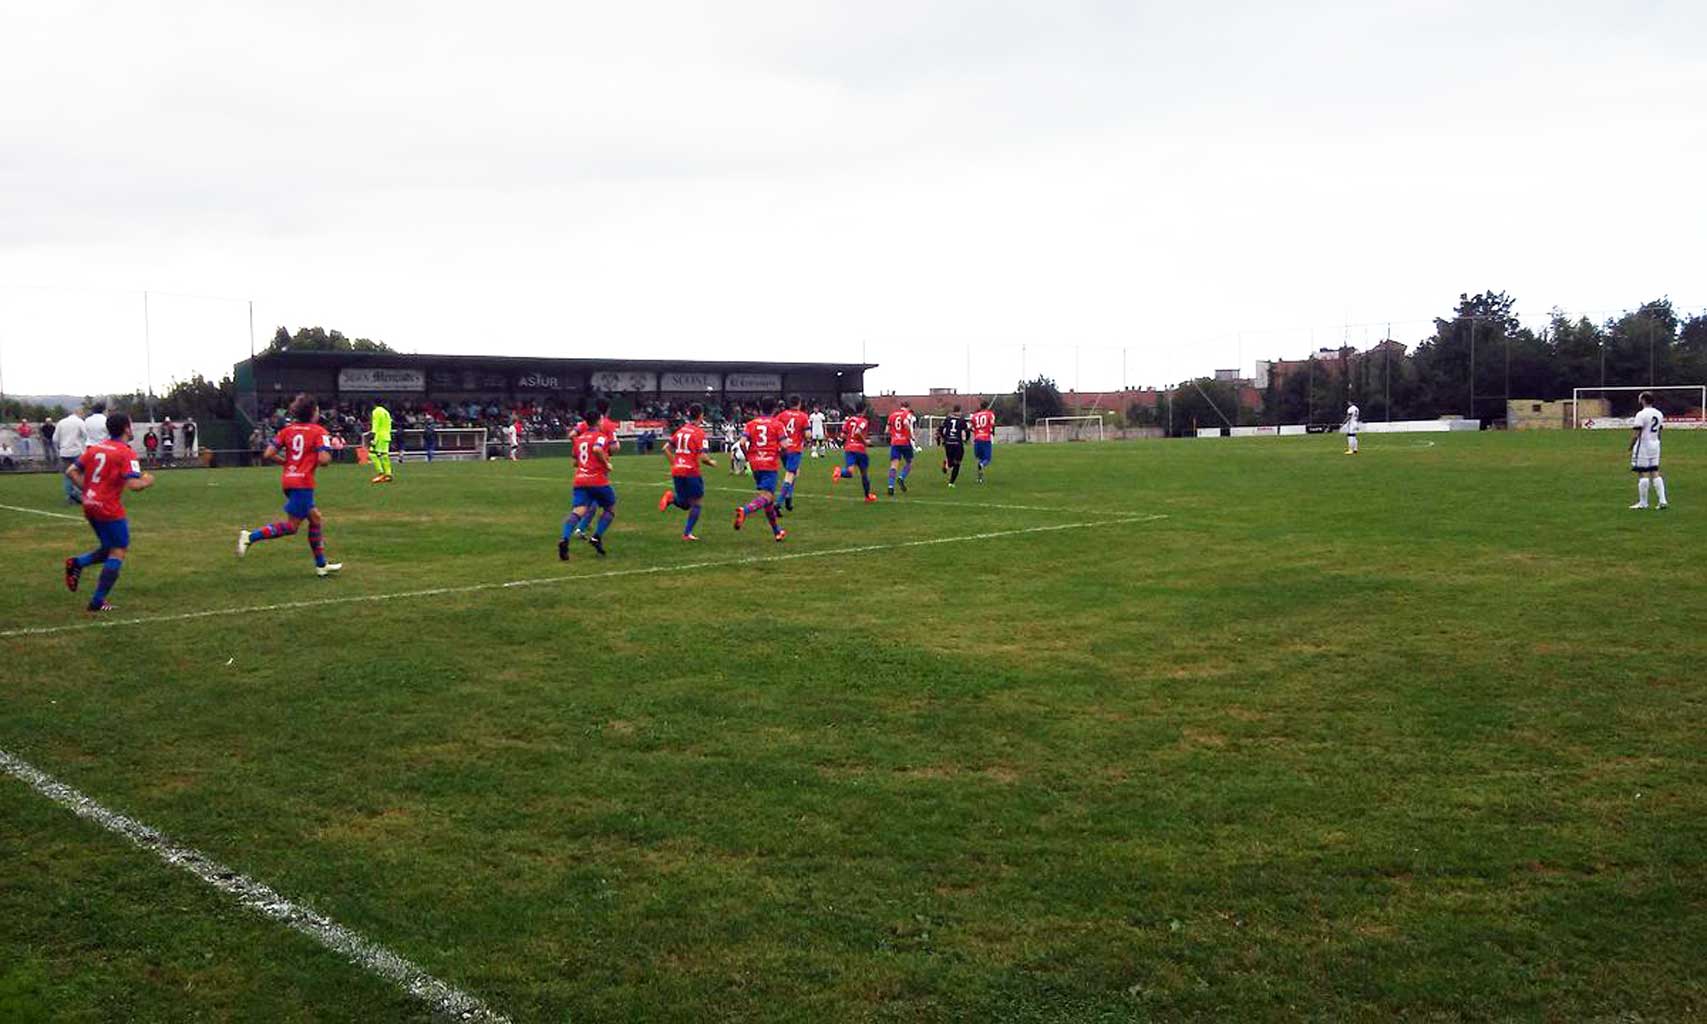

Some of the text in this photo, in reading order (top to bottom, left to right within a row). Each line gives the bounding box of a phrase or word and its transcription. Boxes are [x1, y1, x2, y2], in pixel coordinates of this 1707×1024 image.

[518, 374, 558, 387] ASTUR
[786, 417, 795, 434] 4
[895, 416, 902, 431] 6
[950, 419, 957, 432] 1
[974, 415, 987, 429] 10
[1650, 416, 1659, 433] 2
[675, 432, 691, 454] 11
[756, 424, 767, 447] 3
[292, 434, 304, 461] 9
[579, 441, 589, 465] 8
[91, 452, 107, 483] 2
